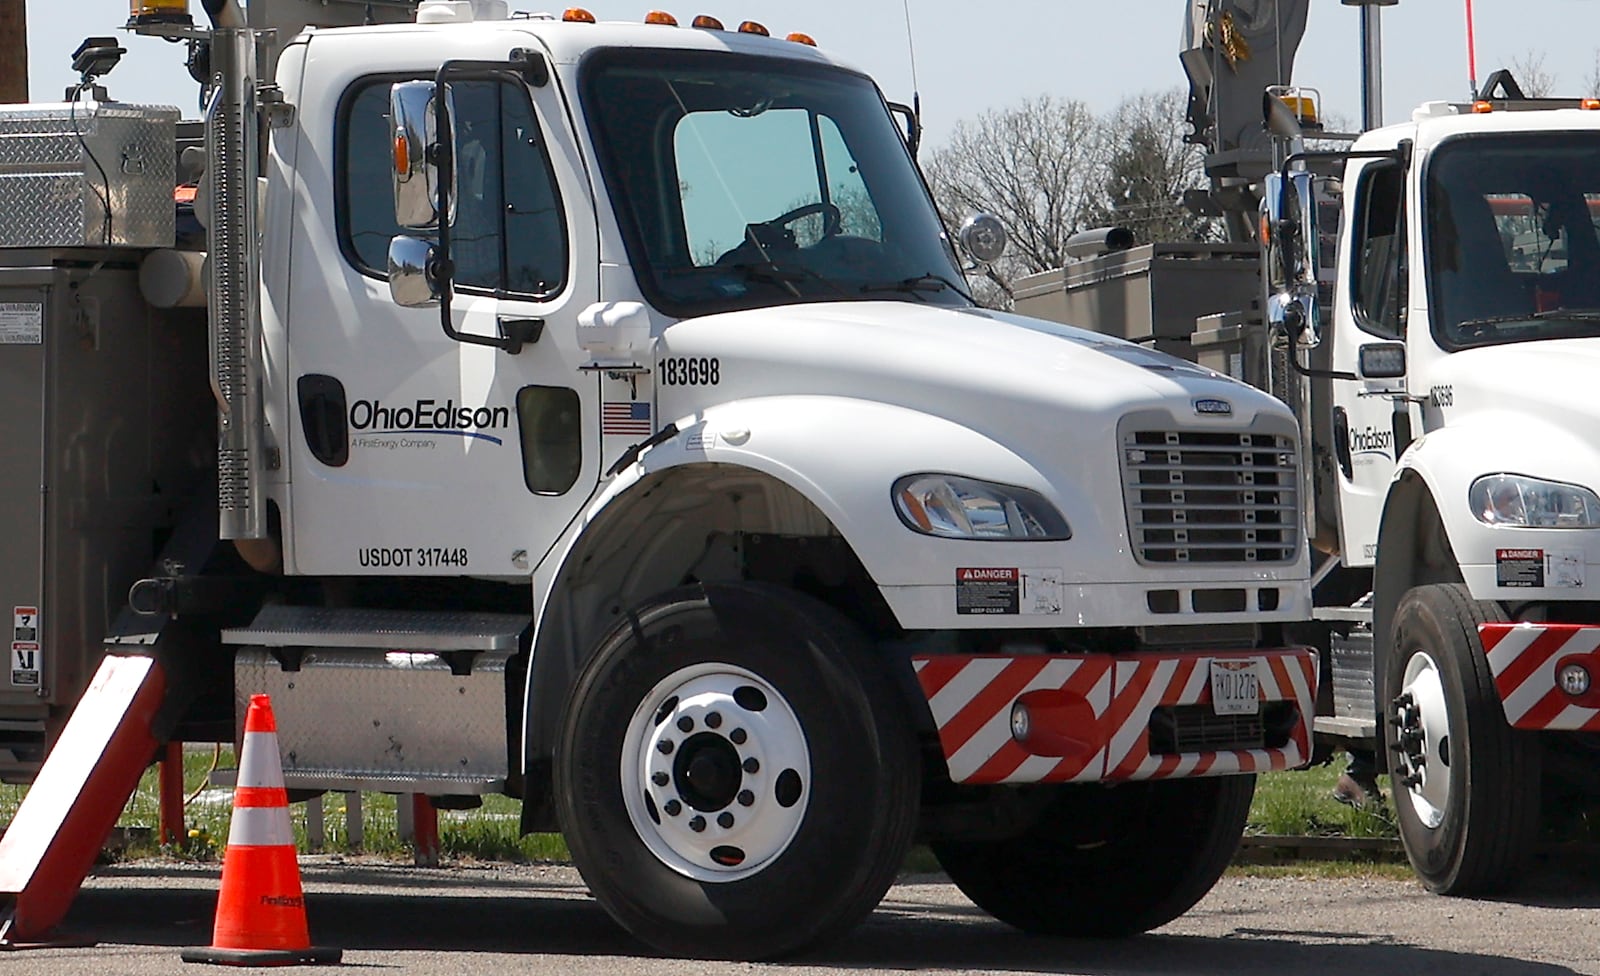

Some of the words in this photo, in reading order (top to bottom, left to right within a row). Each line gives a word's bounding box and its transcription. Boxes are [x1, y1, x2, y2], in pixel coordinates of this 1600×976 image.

[658, 357, 720, 386] 183698
[350, 399, 509, 430] OhioEdison
[351, 438, 358, 447] A
[358, 438, 398, 449] FirstEnergy
[400, 438, 436, 449] Company
[1350, 426, 1392, 451] OhioEdison
[358, 548, 413, 567] USDOT
[417, 548, 468, 567] 317448
[1507, 550, 1539, 559] DANGER
[974, 569, 1013, 579] DANGER
[1233, 673, 1256, 700] 1276
